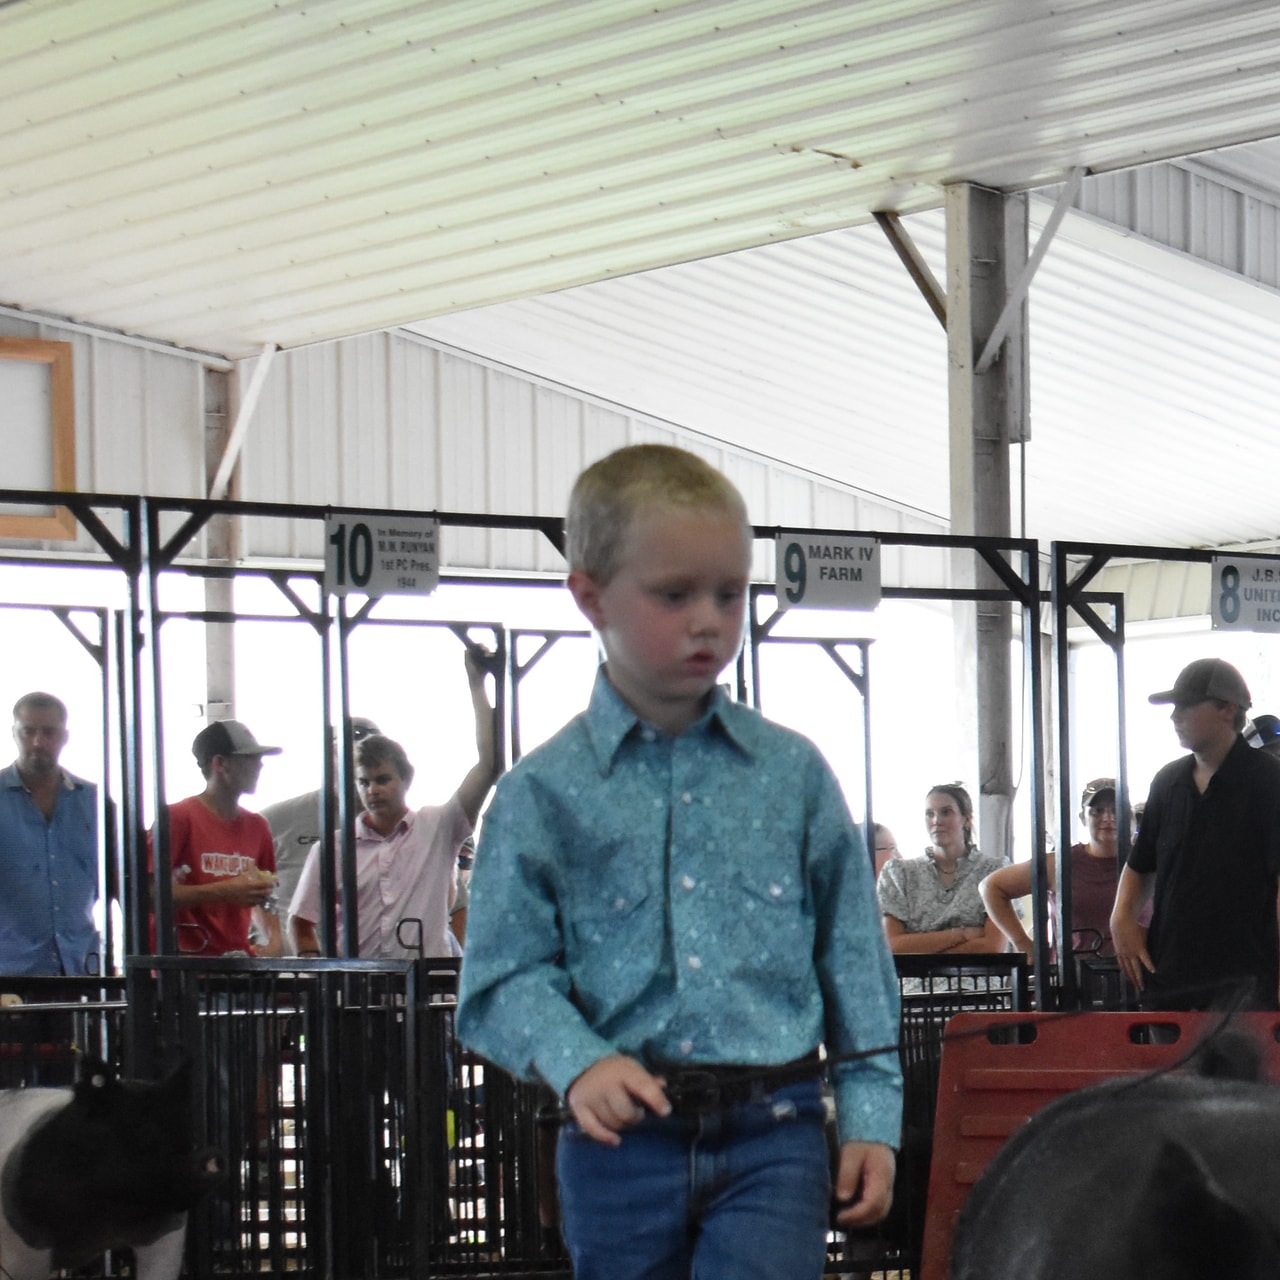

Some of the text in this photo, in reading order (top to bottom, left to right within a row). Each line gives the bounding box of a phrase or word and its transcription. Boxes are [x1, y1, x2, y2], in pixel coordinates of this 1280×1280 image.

[329, 523, 373, 587] 10
[784, 542, 806, 604] 9
[808, 545, 873, 561] MARK IV
[820, 566, 863, 582] FARM
[1219, 565, 1240, 623] 8
